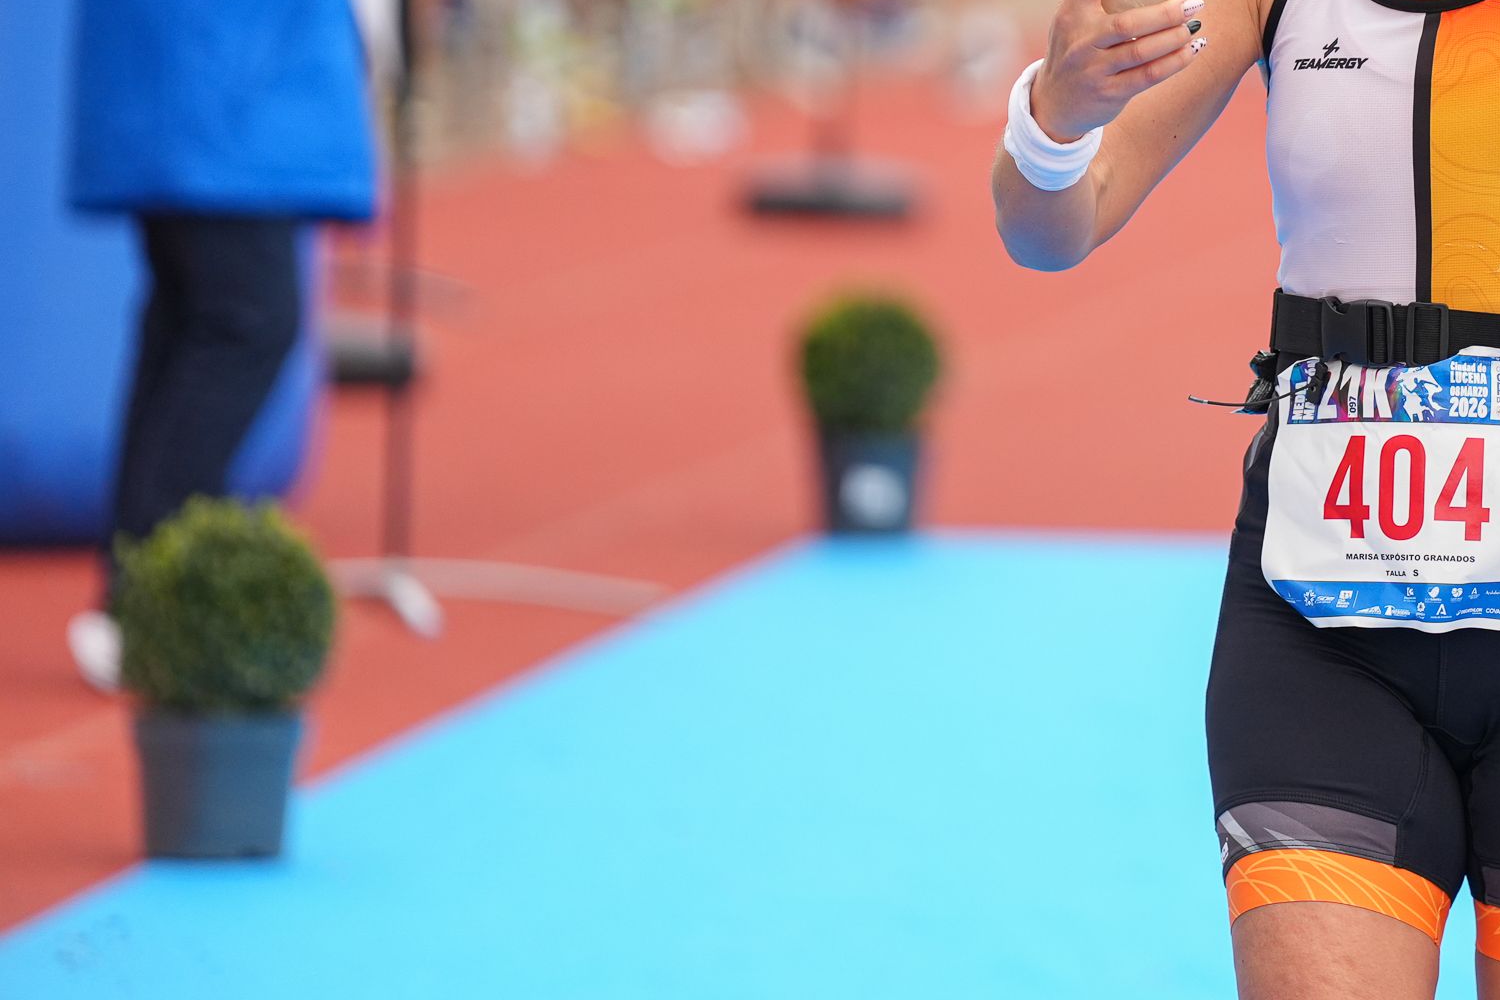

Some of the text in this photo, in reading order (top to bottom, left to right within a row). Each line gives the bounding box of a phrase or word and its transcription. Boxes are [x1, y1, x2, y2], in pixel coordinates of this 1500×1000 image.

[1293, 56, 1369, 71] TEAMERGY
[1450, 361, 1487, 373] Ciudad de
[1450, 371, 1487, 384] LUCENA
[1449, 397, 1488, 419] 2026
[1323, 434, 1490, 541] 404
[1345, 552, 1475, 563] MARISA EXPÓSITO GRANADOS
[1413, 569, 1419, 577] S
